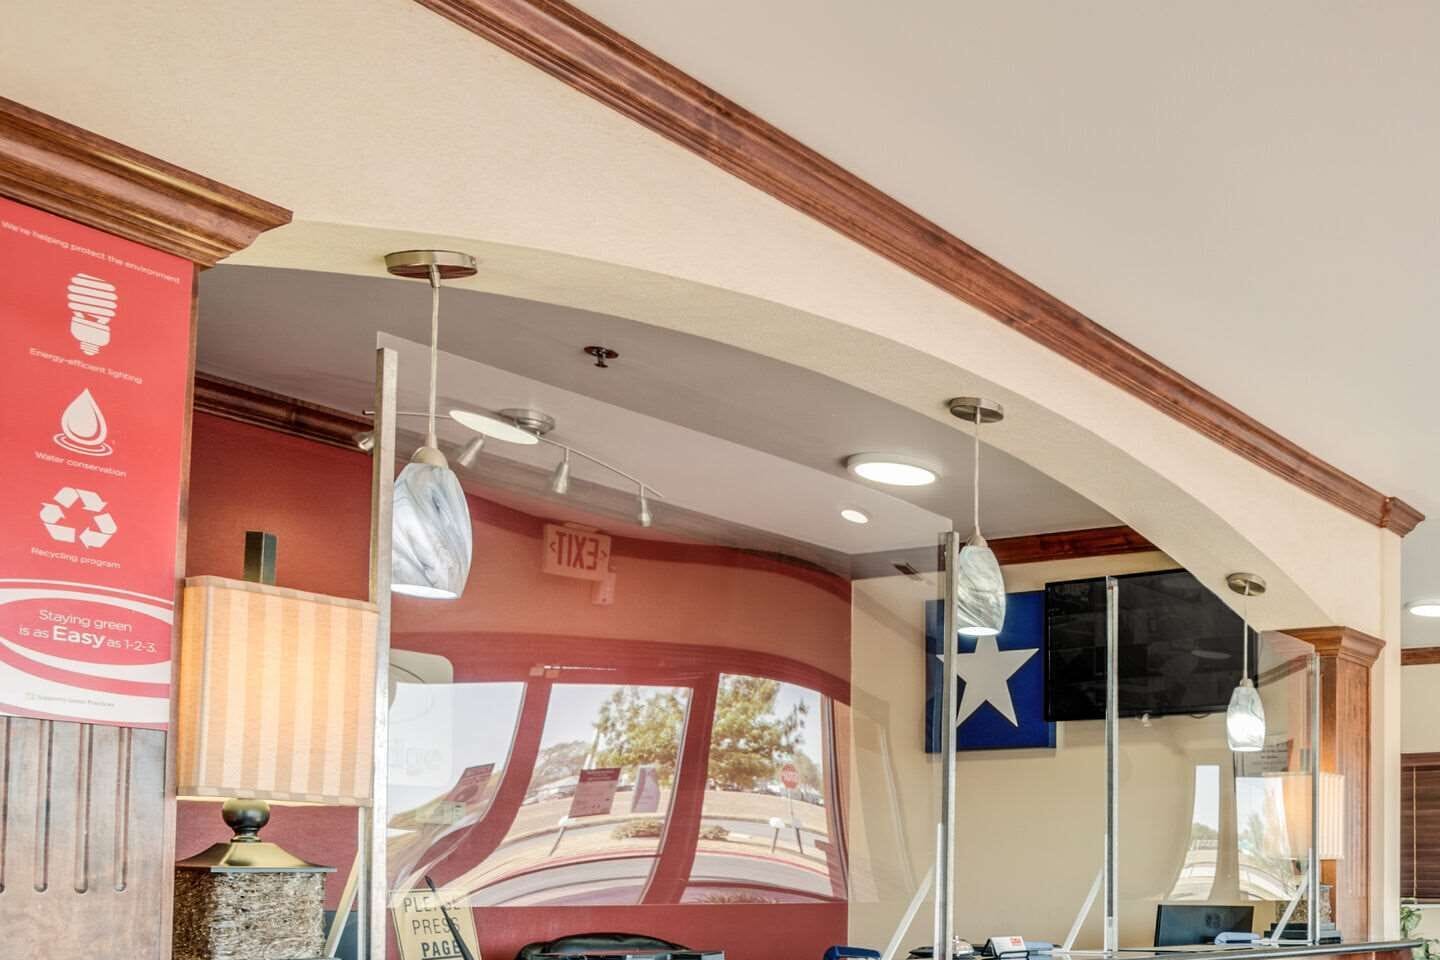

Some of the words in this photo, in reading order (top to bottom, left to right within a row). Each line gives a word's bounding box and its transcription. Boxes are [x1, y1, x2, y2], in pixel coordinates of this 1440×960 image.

[32, 230, 70, 250] helping
[70, 244, 105, 261] protect
[107, 254, 123, 266] the
[124, 261, 180, 284] environment
[107, 368, 143, 385] lighting
[34, 451, 65, 464] Water
[66, 459, 127, 478] conservation
[31, 547, 79, 564] Recycling
[80, 556, 121, 570] program
[39, 609, 91, 630] Staying
[93, 619, 133, 633] green
[18, 624, 31, 637] is
[32, 628, 50, 640] as
[53, 624, 106, 649] Easy
[106, 638, 122, 649] as
[403, 894, 462, 912] PLE
[421, 939, 462, 957] PAGE
